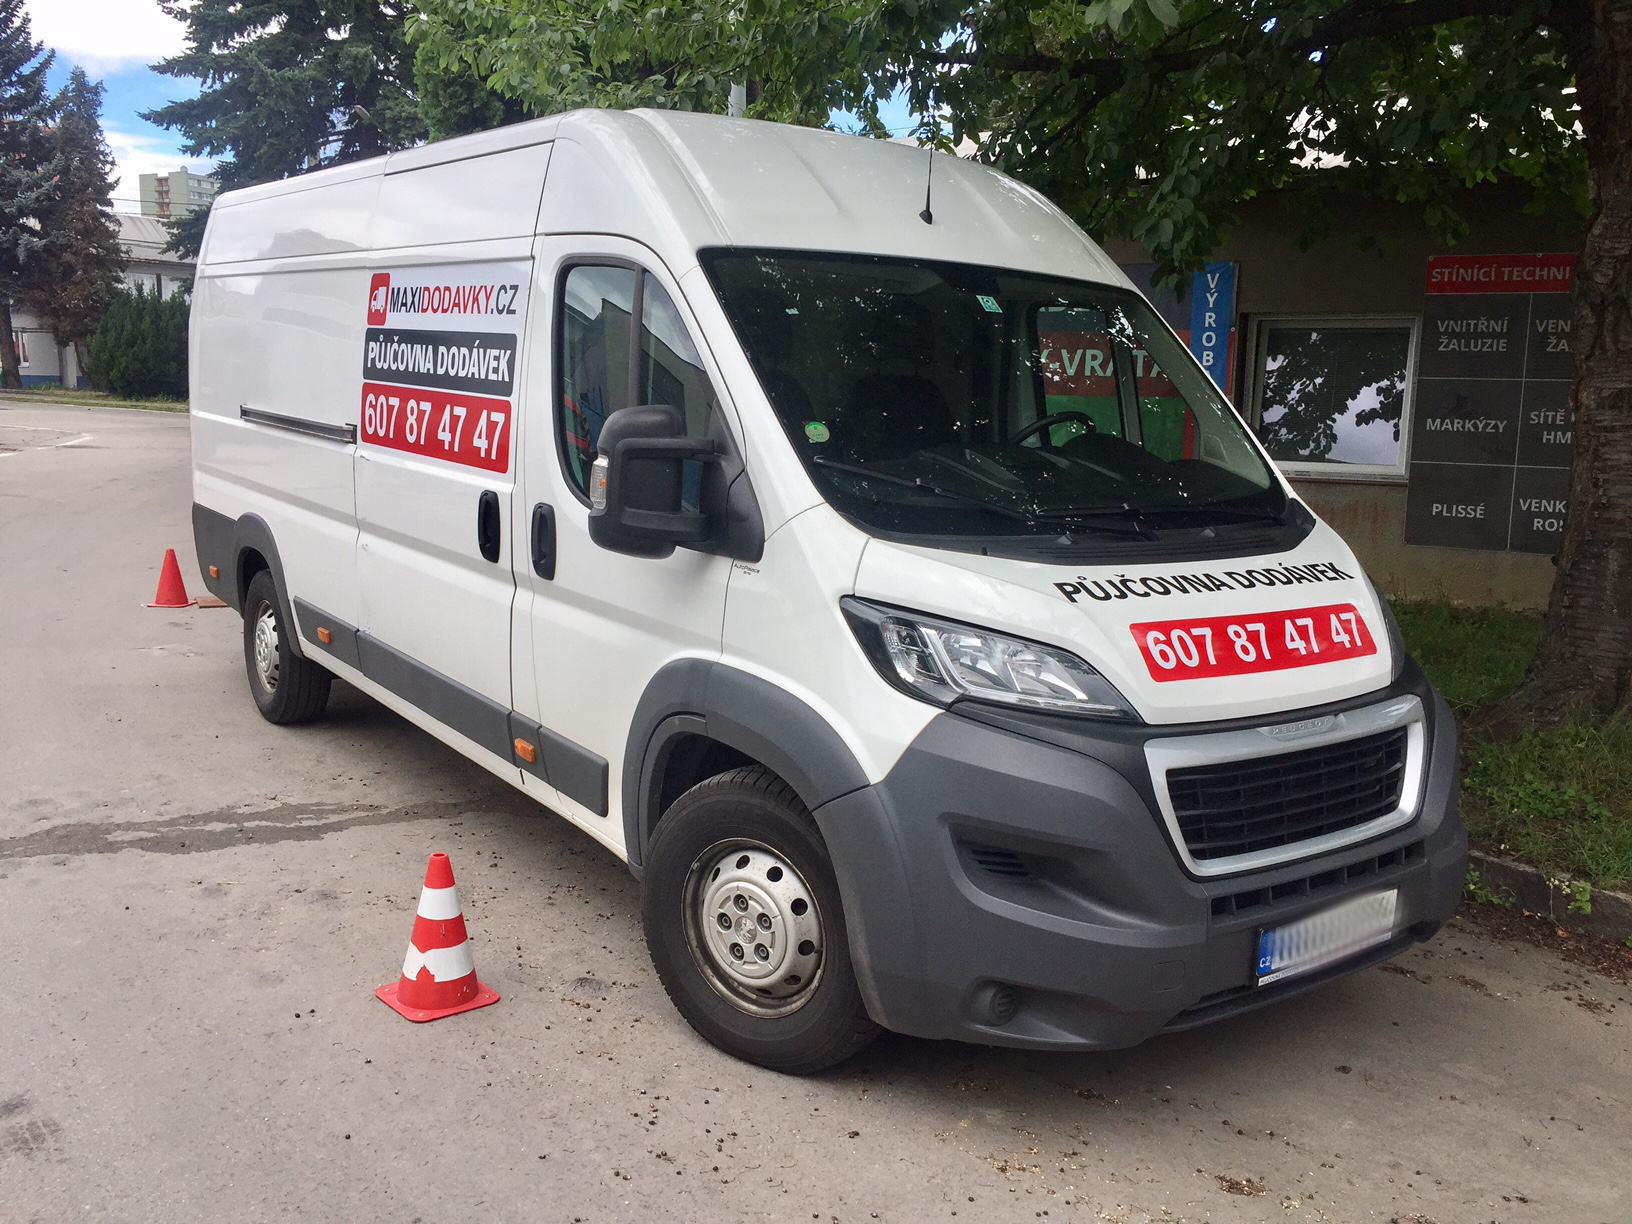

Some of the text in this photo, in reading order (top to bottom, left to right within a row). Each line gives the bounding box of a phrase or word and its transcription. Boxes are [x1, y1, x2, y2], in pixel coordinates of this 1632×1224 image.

[1431, 264, 1497, 282] STÍNÍCÍ
[388, 284, 519, 315] MAXIDODAVKY.CZ
[1202, 273, 1219, 377] VÝROB
[1437, 316, 1510, 333] VNITŘNÍ
[1438, 335, 1508, 352] ŽALUZIE
[1546, 335, 1572, 352] ŽA
[367, 335, 512, 382] PŮJČOVNA DODÁVEK
[1426, 417, 1508, 433] MARKÝZY
[1529, 408, 1566, 425] SÍTĚ
[364, 393, 506, 460] 607 87 47 47
[1542, 431, 1575, 444] HM
[1432, 503, 1486, 519] PLISSÉ
[1519, 499, 1567, 513] VENK
[1052, 562, 1356, 604] PŮJČOVNA DODÁVEK
[1146, 612, 1362, 670] 607 87 47 47
[1272, 718, 1329, 735] PEUGEOT
[1260, 956, 1271, 968] CZ
